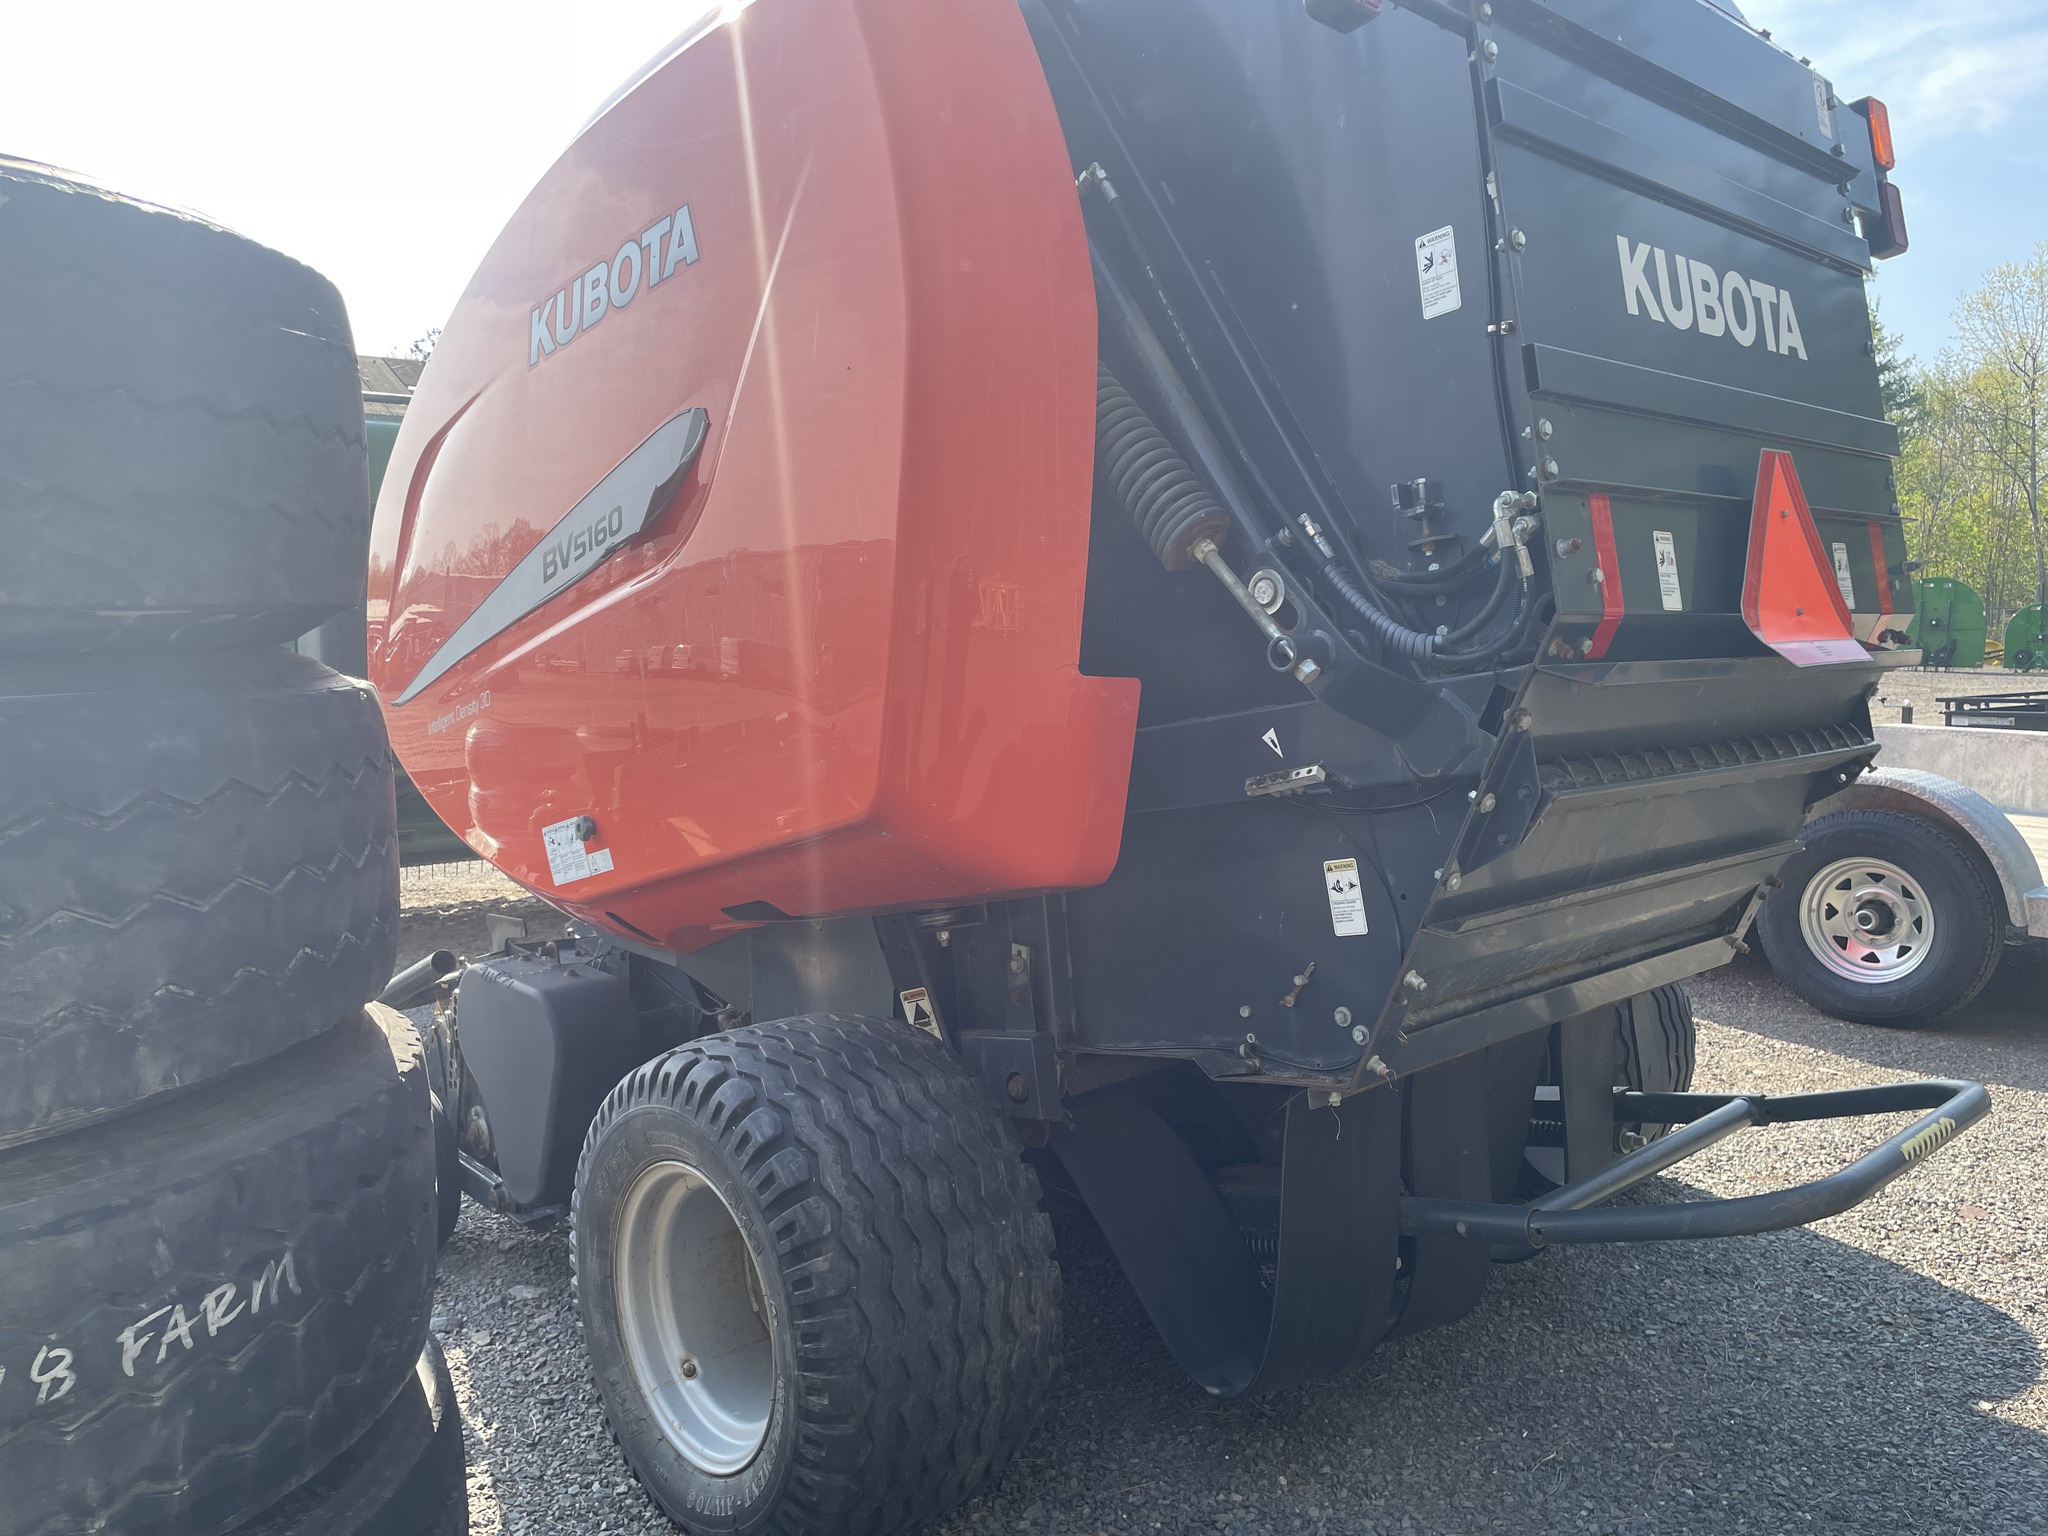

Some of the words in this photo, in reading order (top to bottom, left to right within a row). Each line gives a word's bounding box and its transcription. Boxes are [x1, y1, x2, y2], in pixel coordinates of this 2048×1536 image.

[529, 202, 701, 368] KUBOTA
[1427, 231, 1450, 244] WARNING
[1616, 234, 1809, 361] KUBOTA
[542, 504, 623, 585] BV5160
[428, 711, 455, 735] Intelligent
[456, 699, 480, 721] Density
[480, 690, 491, 709] 3D
[116, 1246, 303, 1377] FARM
